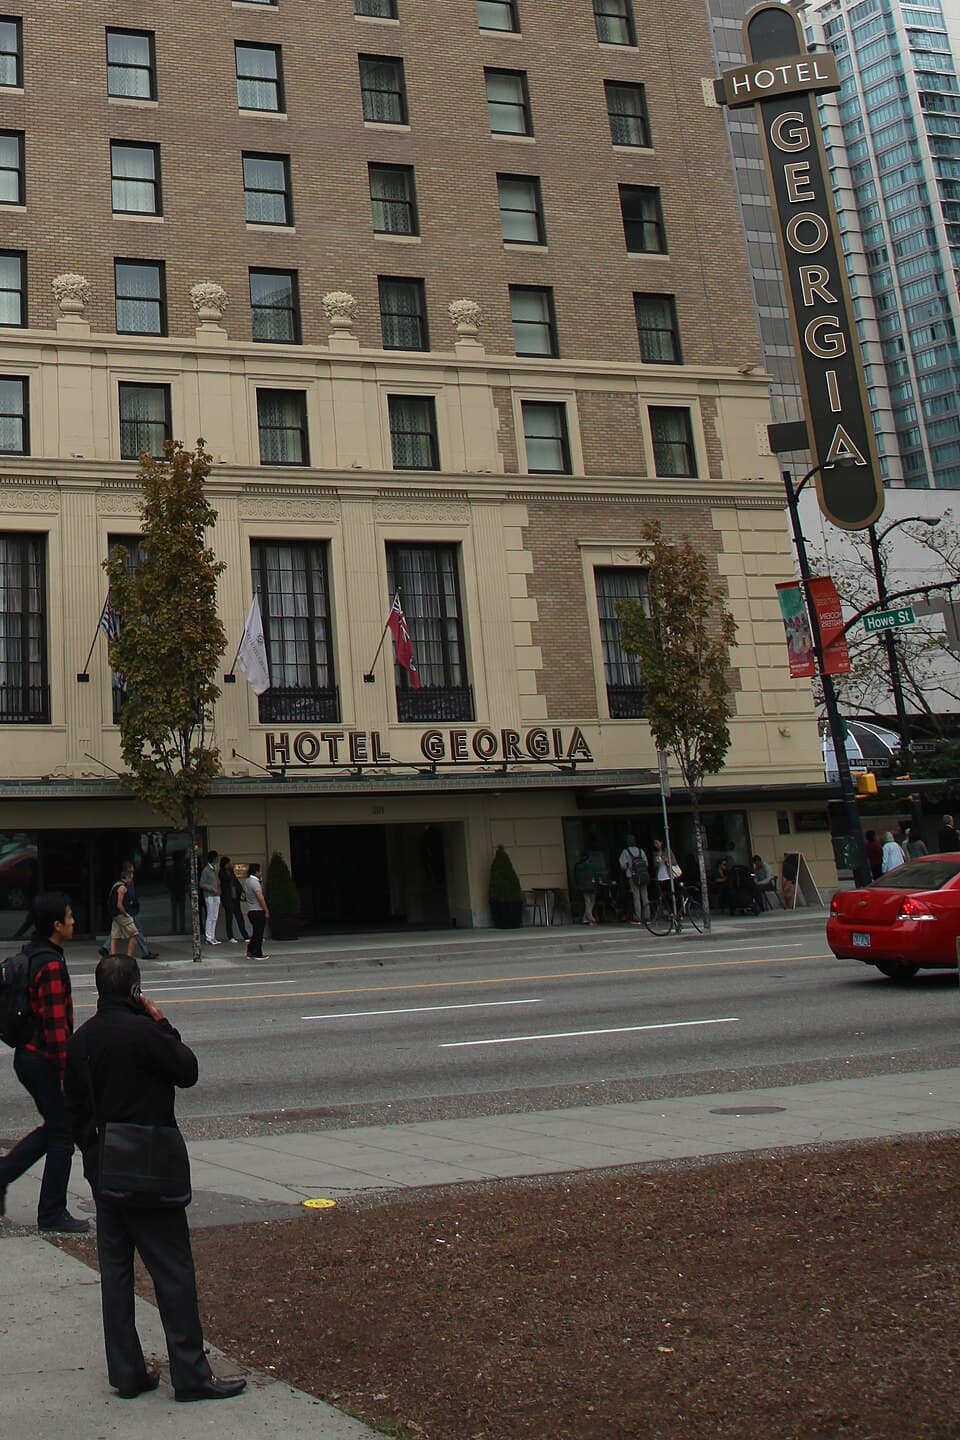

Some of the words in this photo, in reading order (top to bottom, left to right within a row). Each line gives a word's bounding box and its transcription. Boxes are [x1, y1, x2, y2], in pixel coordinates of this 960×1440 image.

[732, 62, 829, 95] HOTEL
[770, 111, 868, 470] GEORGIA
[867, 615, 895, 630] Howe
[897, 610, 911, 624] St
[265, 731, 391, 764] HOTEL
[420, 727, 594, 762] GEORGIA
